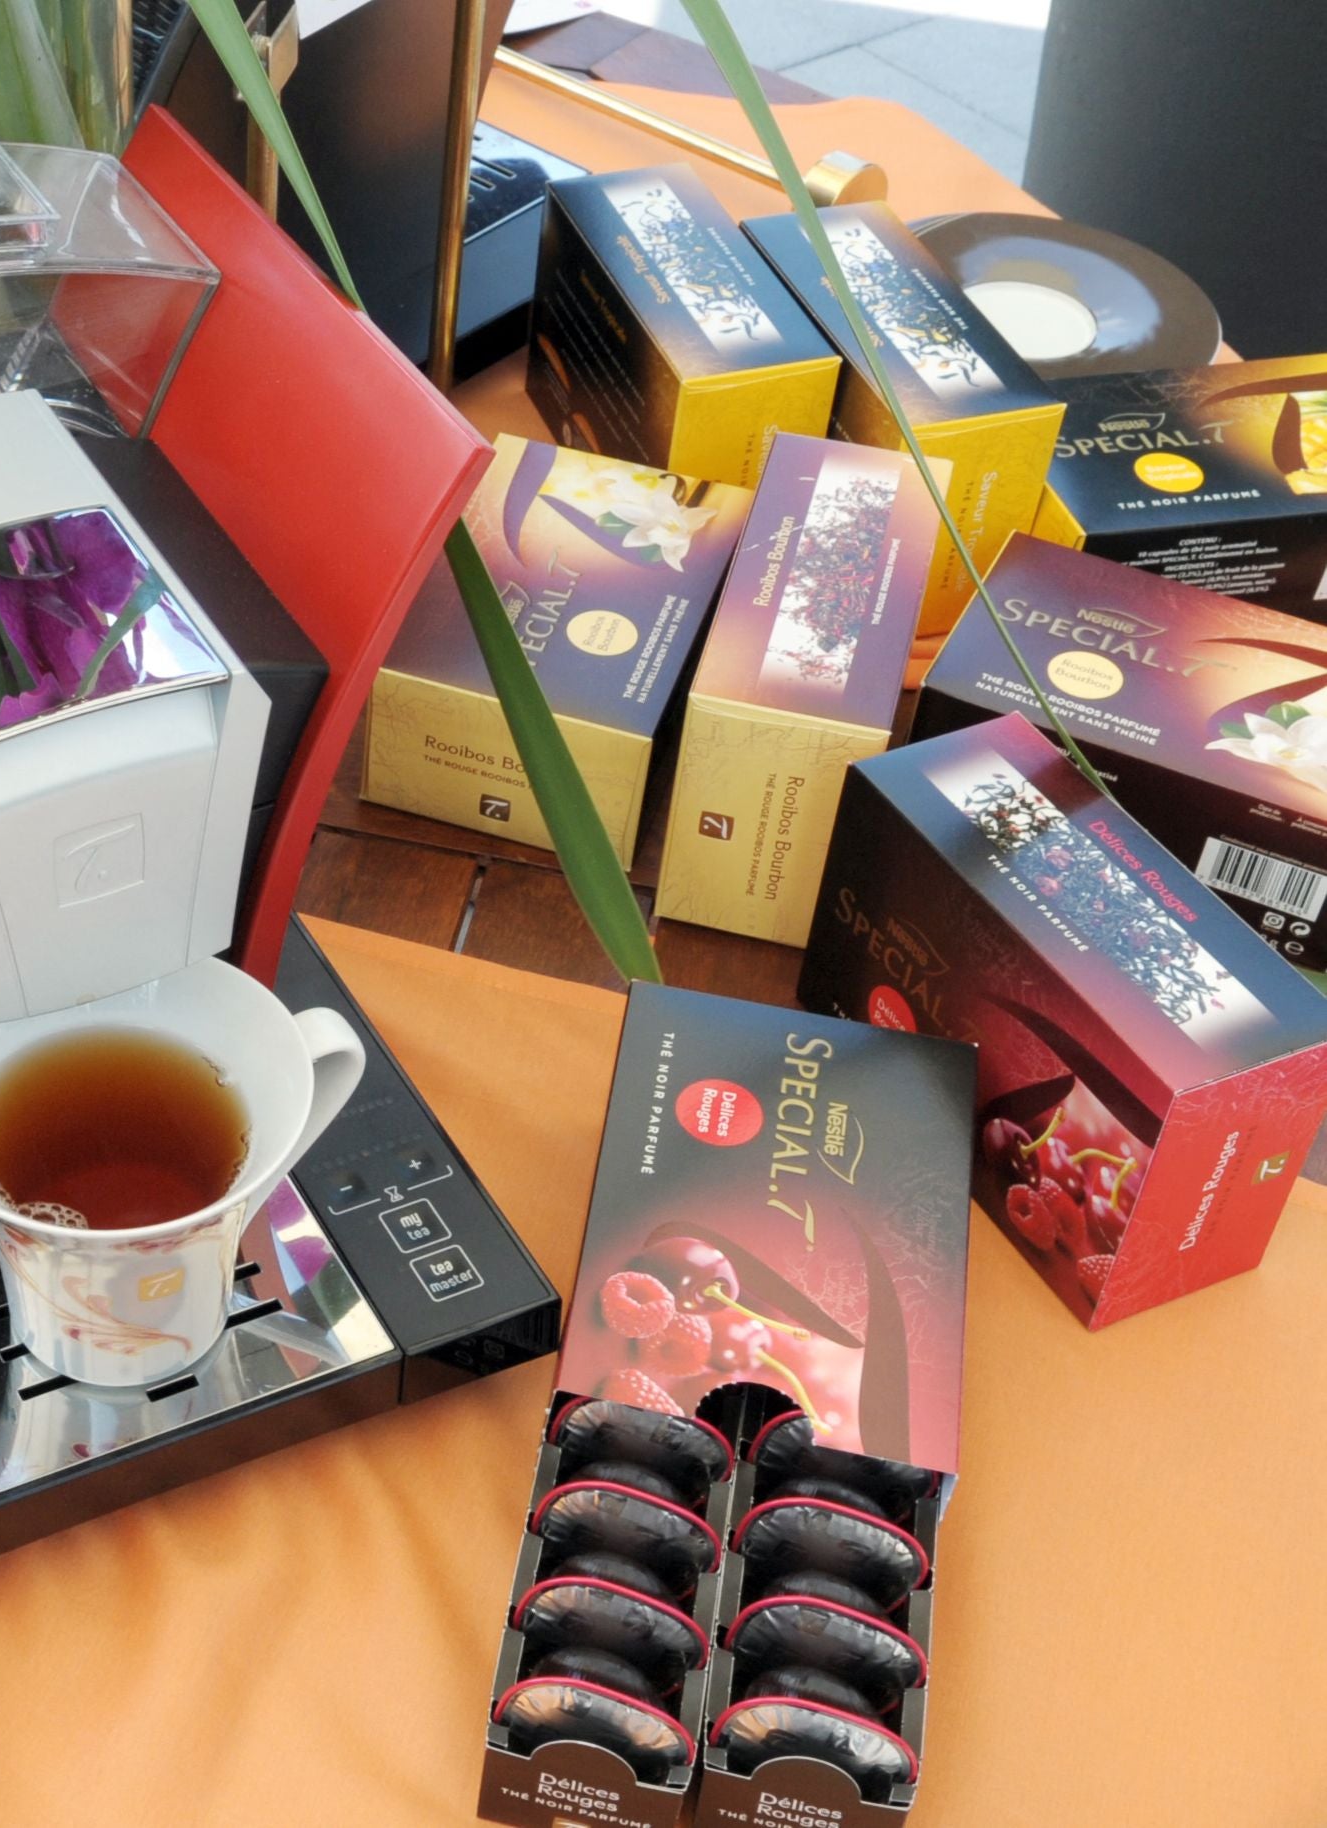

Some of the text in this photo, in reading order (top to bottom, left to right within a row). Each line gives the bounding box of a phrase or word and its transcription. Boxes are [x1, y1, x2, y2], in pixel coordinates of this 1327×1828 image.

[1117, 489, 1261, 511] THÉ NOIR PARFUMÉ
[753, 515, 795, 607] Rooibos Bourbon
[1054, 667, 1112, 691] Bourbon
[1060, 656, 1115, 681] Rooibos
[981, 672, 1161, 736] THÉ ROOIBOS PARFUMÉ
[1078, 714, 1110, 731] SANS
[1112, 725, 1158, 746] THÉINE
[424, 735, 495, 765] Rooibos
[444, 760, 478, 775] ROUGE
[760, 790, 773, 820] ROUGE
[764, 776, 805, 900] Rooibos Bourbon
[1088, 818, 1199, 923] Délices Rouges
[987, 854, 1089, 952] THÉ NOIR PARFUMÉ
[640, 1032, 675, 1175] THÉ NOIR PARFUMÉ
[697, 1087, 718, 1133] Rouges
[716, 1090, 737, 1137] Délices
[823, 1101, 849, 1157] Nestlé
[1178, 1193, 1215, 1251] Délices
[1202, 1131, 1240, 1192] Rouges
[399, 1212, 423, 1229] my
[406, 1226, 431, 1241] tea
[429, 1260, 454, 1276] tea
[429, 1269, 474, 1293] master
[500, 1787, 530, 1801] THÉ
[535, 1797, 574, 1812] NOIR
[537, 1783, 618, 1812] Rouges
[540, 1772, 620, 1801] Délices
[718, 1808, 748, 1822] THÉ
[757, 1803, 840, 1828] Rouges
[759, 1792, 843, 1820] Délices
